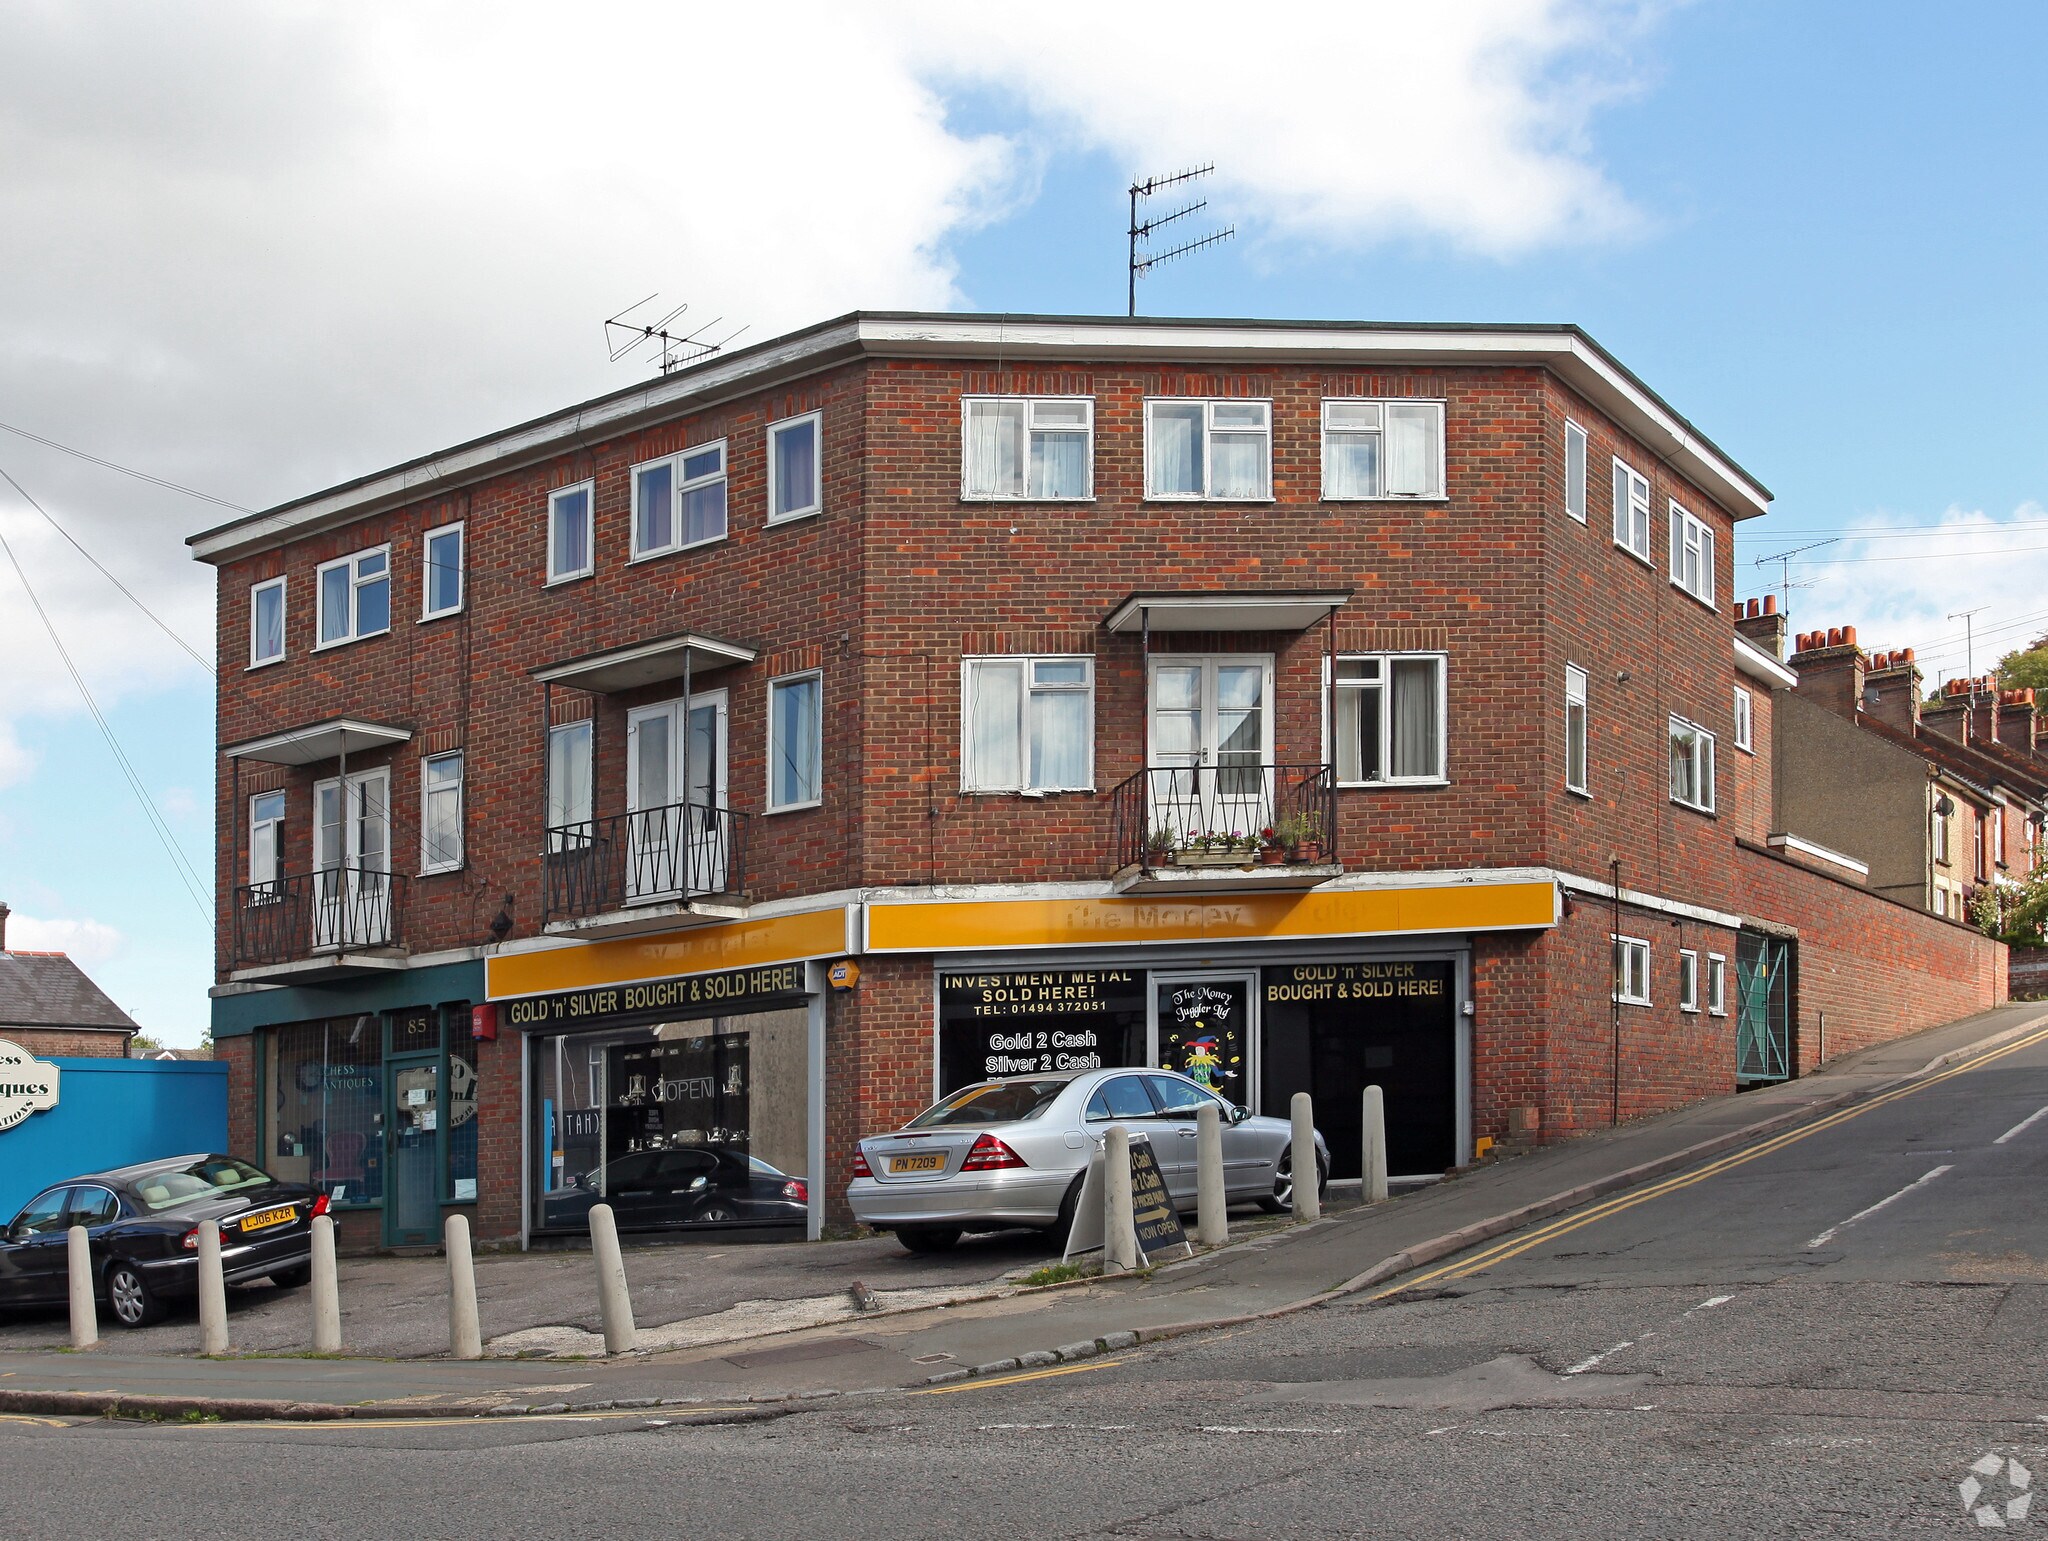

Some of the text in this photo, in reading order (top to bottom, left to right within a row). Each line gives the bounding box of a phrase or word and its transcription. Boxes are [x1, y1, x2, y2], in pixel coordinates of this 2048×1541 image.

[833, 970, 845, 979] ADT
[945, 970, 1132, 989] INVESTMENT METAL
[1293, 965, 1337, 981] GOLD
[1362, 963, 1415, 979] SILVER
[511, 1000, 548, 1023] GOLD
[570, 991, 618, 1017] SILVER
[625, 981, 686, 1010] BOUGHT
[690, 979, 701, 1001] &
[705, 974, 746, 999] SOLD
[751, 967, 798, 994] HERE!
[982, 985, 1095, 1003] SOLD HERE!
[1172, 986, 1233, 1006] The Money
[1267, 979, 1443, 1001] BOUGHT & SOLD HERE!
[974, 1001, 1107, 1015] TEL: 01494 372051
[1175, 1003, 1231, 1022] Juggler Ltd
[407, 1018, 427, 1034] 85
[989, 1029, 1098, 1051] Gold 2 Cash
[985, 1051, 1101, 1074] Silver 2 Cash
[324, 1077, 374, 1091] ANTIQUES
[665, 1079, 713, 1102] OPEN
[895, 1156, 937, 1170] PN 7209
[245, 1214, 271, 1228] LJ06
[272, 1207, 292, 1221] KZR
[1140, 1220, 1179, 1240] NOW OPEN
